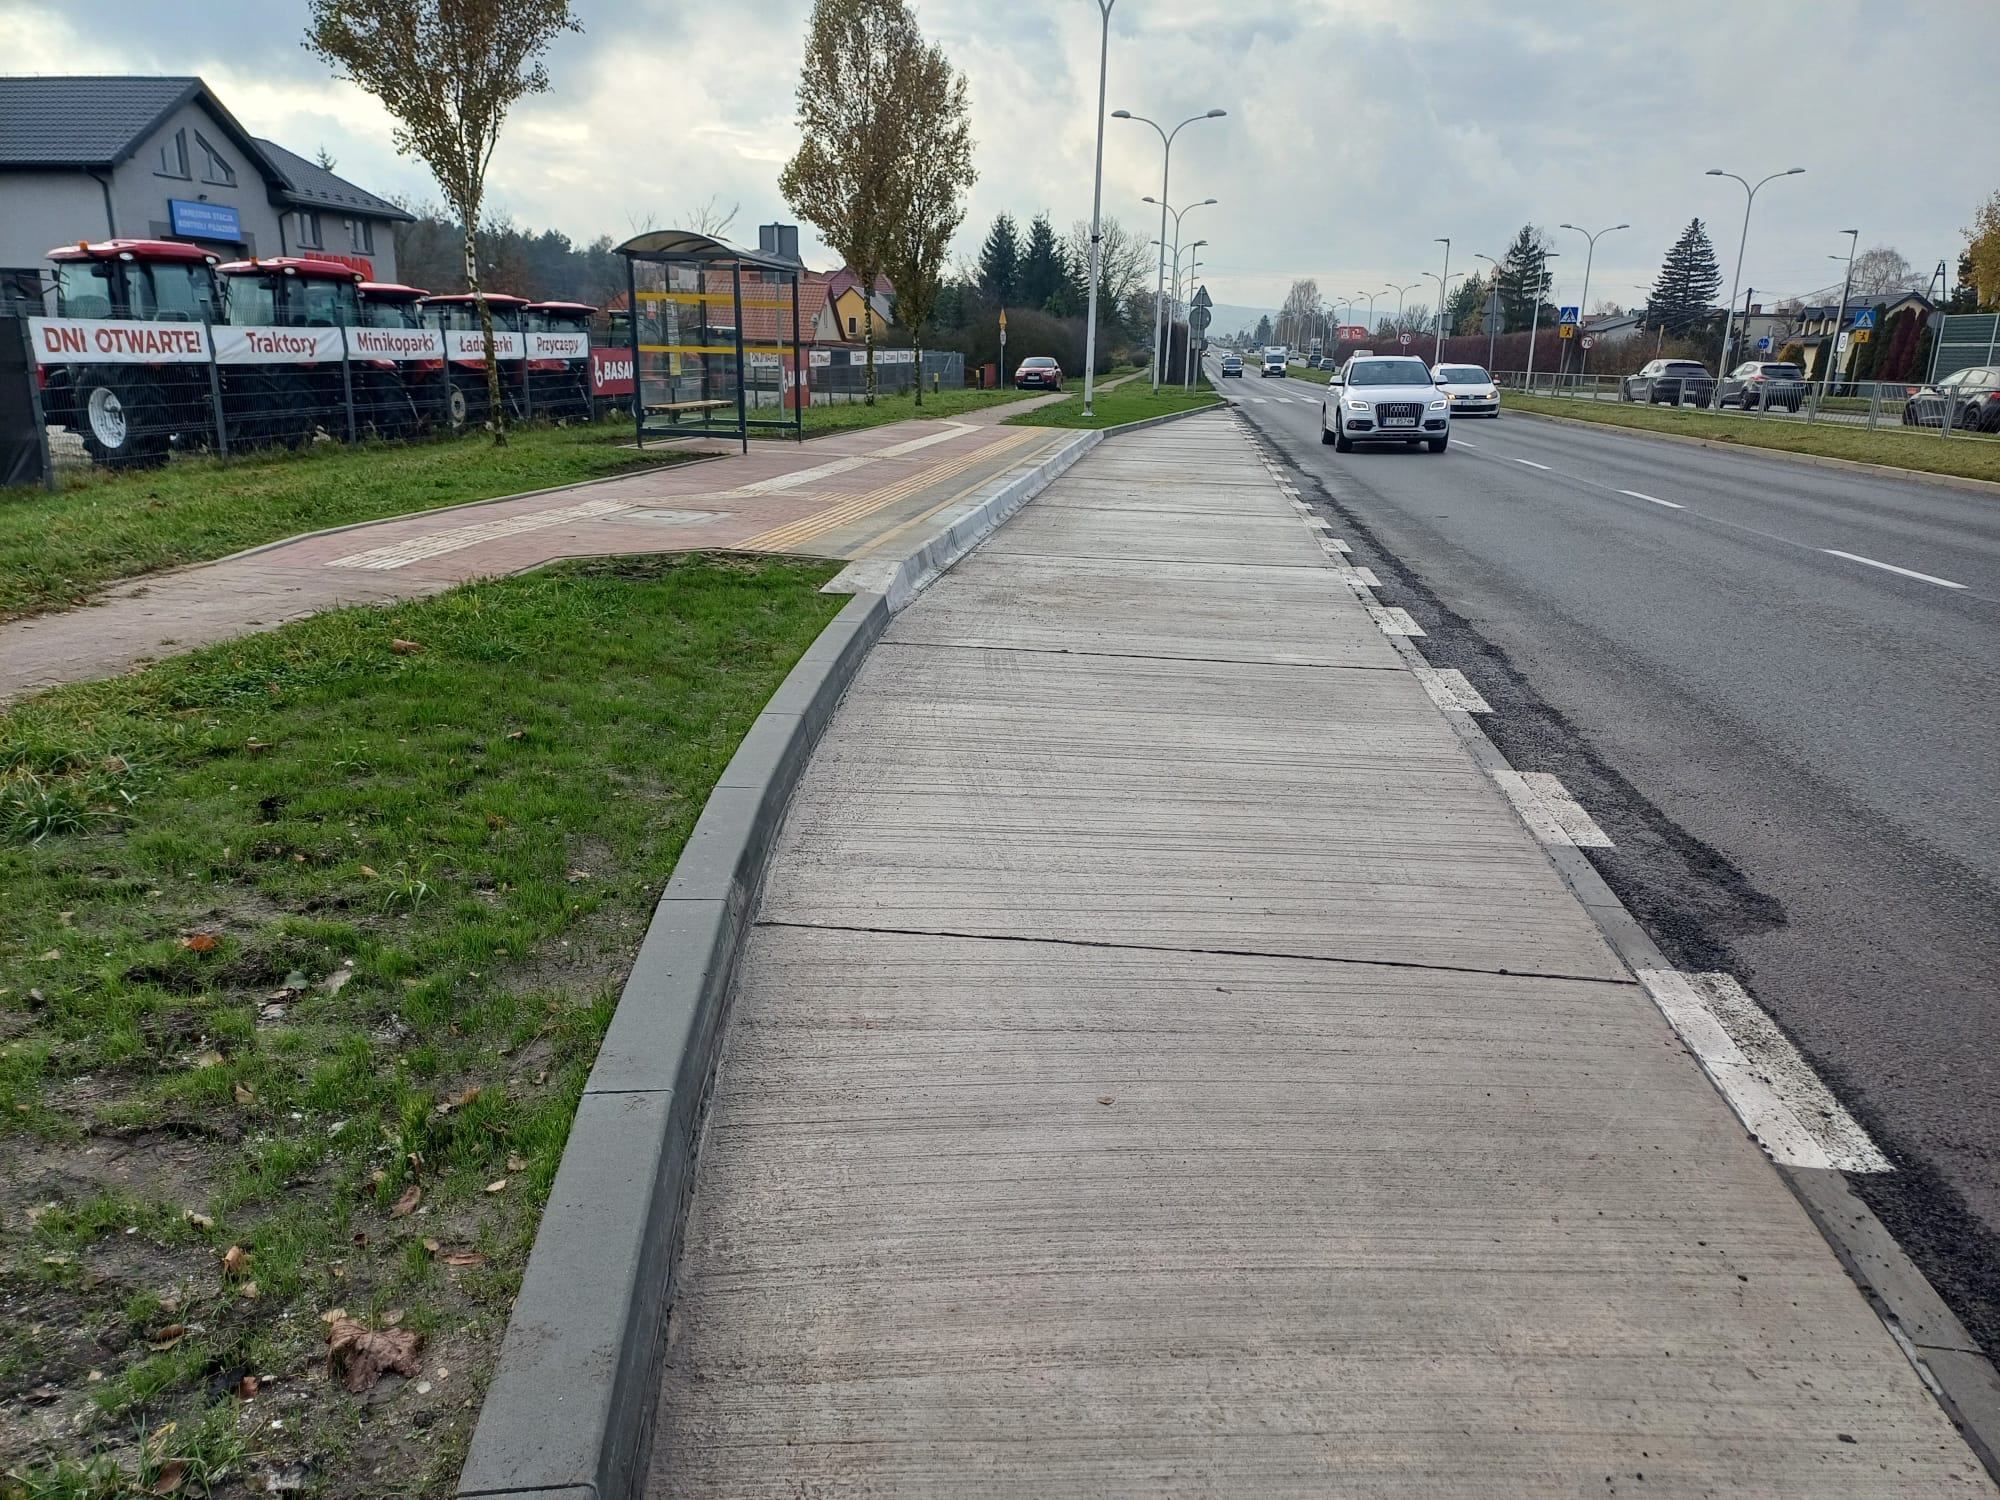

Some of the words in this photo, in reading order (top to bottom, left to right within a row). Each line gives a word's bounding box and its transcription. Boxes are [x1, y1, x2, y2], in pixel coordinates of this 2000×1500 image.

[43, 327, 88, 353] DNI
[95, 328, 202, 354] OTWARTE!
[245, 331, 317, 357] Traktory
[357, 332, 434, 357] Minikoparki
[459, 335, 513, 353] Ładoarki
[536, 336, 579, 354] Przyczepy
[1401, 335, 1411, 343] 70
